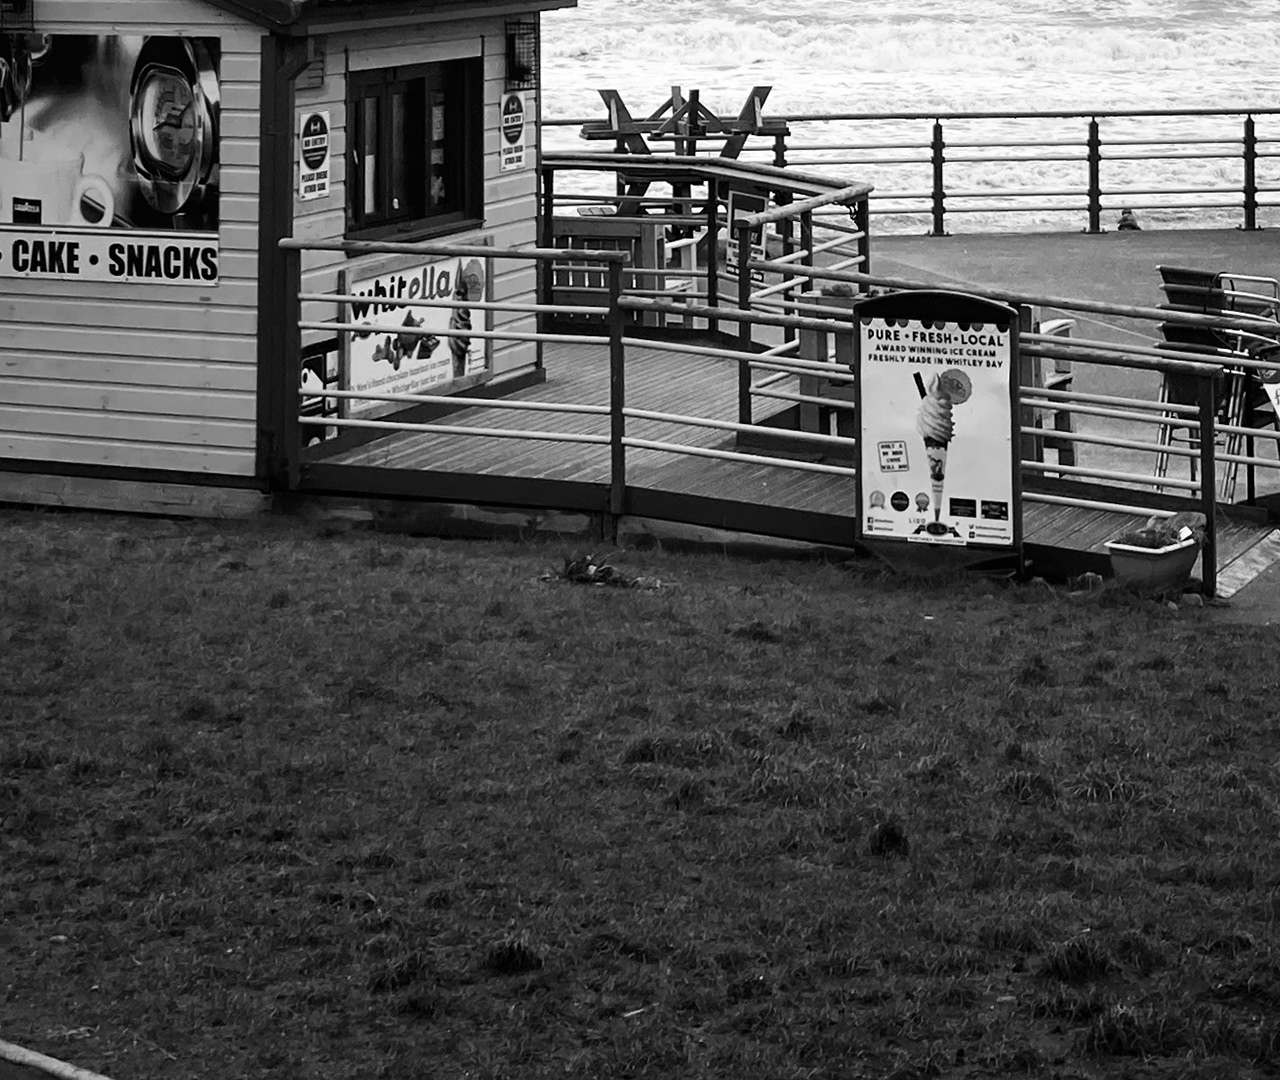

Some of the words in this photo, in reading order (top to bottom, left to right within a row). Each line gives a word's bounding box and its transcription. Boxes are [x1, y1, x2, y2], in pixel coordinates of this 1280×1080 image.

[12, 239, 80, 274] CAKE
[108, 243, 218, 281] SNACKS
[868, 329, 901, 341] PURE
[912, 331, 952, 344] FRESH
[961, 334, 1004, 347] LOCAL
[875, 344, 906, 353] AWARD
[908, 345, 948, 355] WINNING
[950, 348, 964, 356] ICE
[966, 348, 996, 357] CREAM
[868, 354, 905, 363] FRESHLY
[908, 355, 931, 364] MADE
[934, 357, 943, 365] IN
[946, 357, 983, 368] WHITLEY
[986, 360, 1003, 368] BAY
